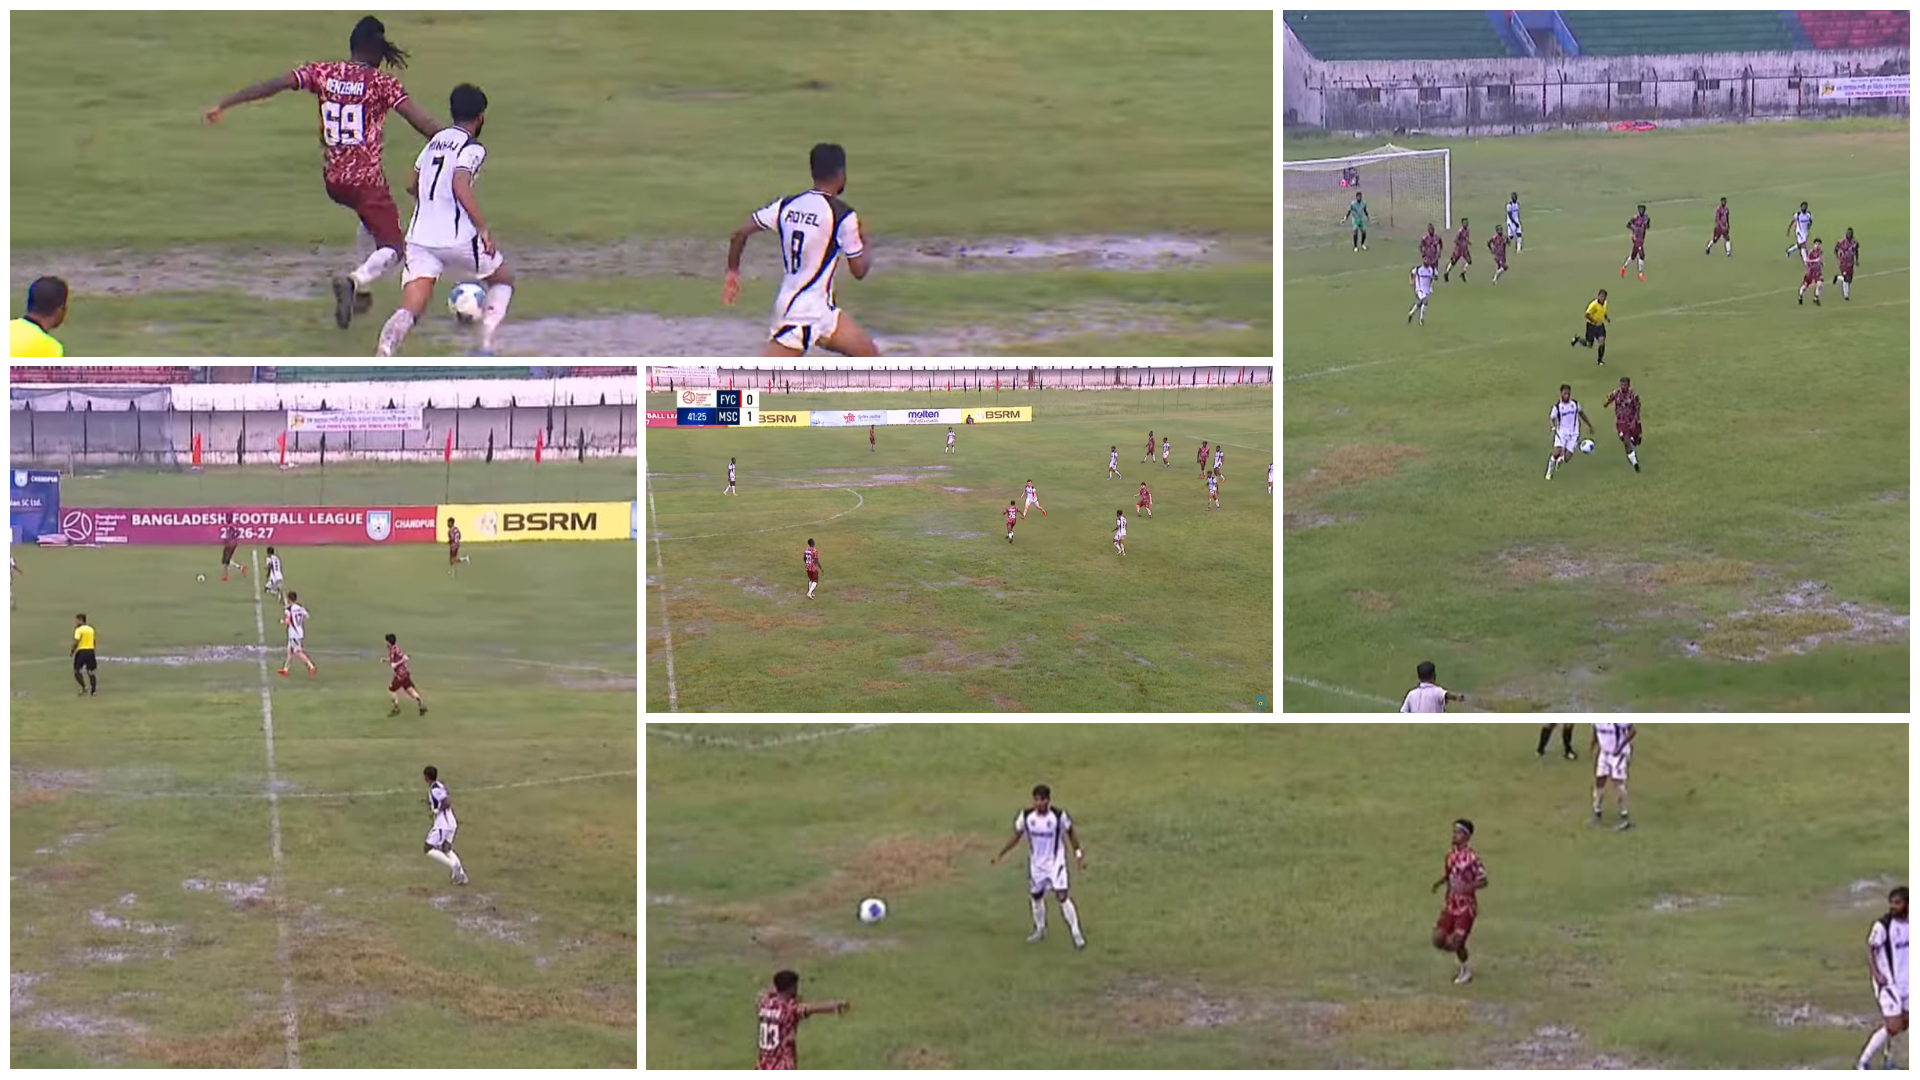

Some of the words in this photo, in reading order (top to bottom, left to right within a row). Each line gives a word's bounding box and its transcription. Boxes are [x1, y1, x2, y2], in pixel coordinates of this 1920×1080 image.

[321, 101, 363, 146] 69
[430, 155, 445, 201] 7
[785, 210, 819, 227] ROYEL
[791, 230, 805, 274] 8
[908, 410, 940, 419] molten
[985, 410, 1020, 419] BSRM
[131, 513, 227, 526] BANGLADESH
[232, 512, 305, 525] FOOTBALL
[309, 513, 363, 525] LEAGUE
[394, 517, 435, 529] CHANDPUR
[503, 512, 597, 532] BSRM
[220, 527, 274, 539] 226-27
[759, 1023, 780, 1051] 03
